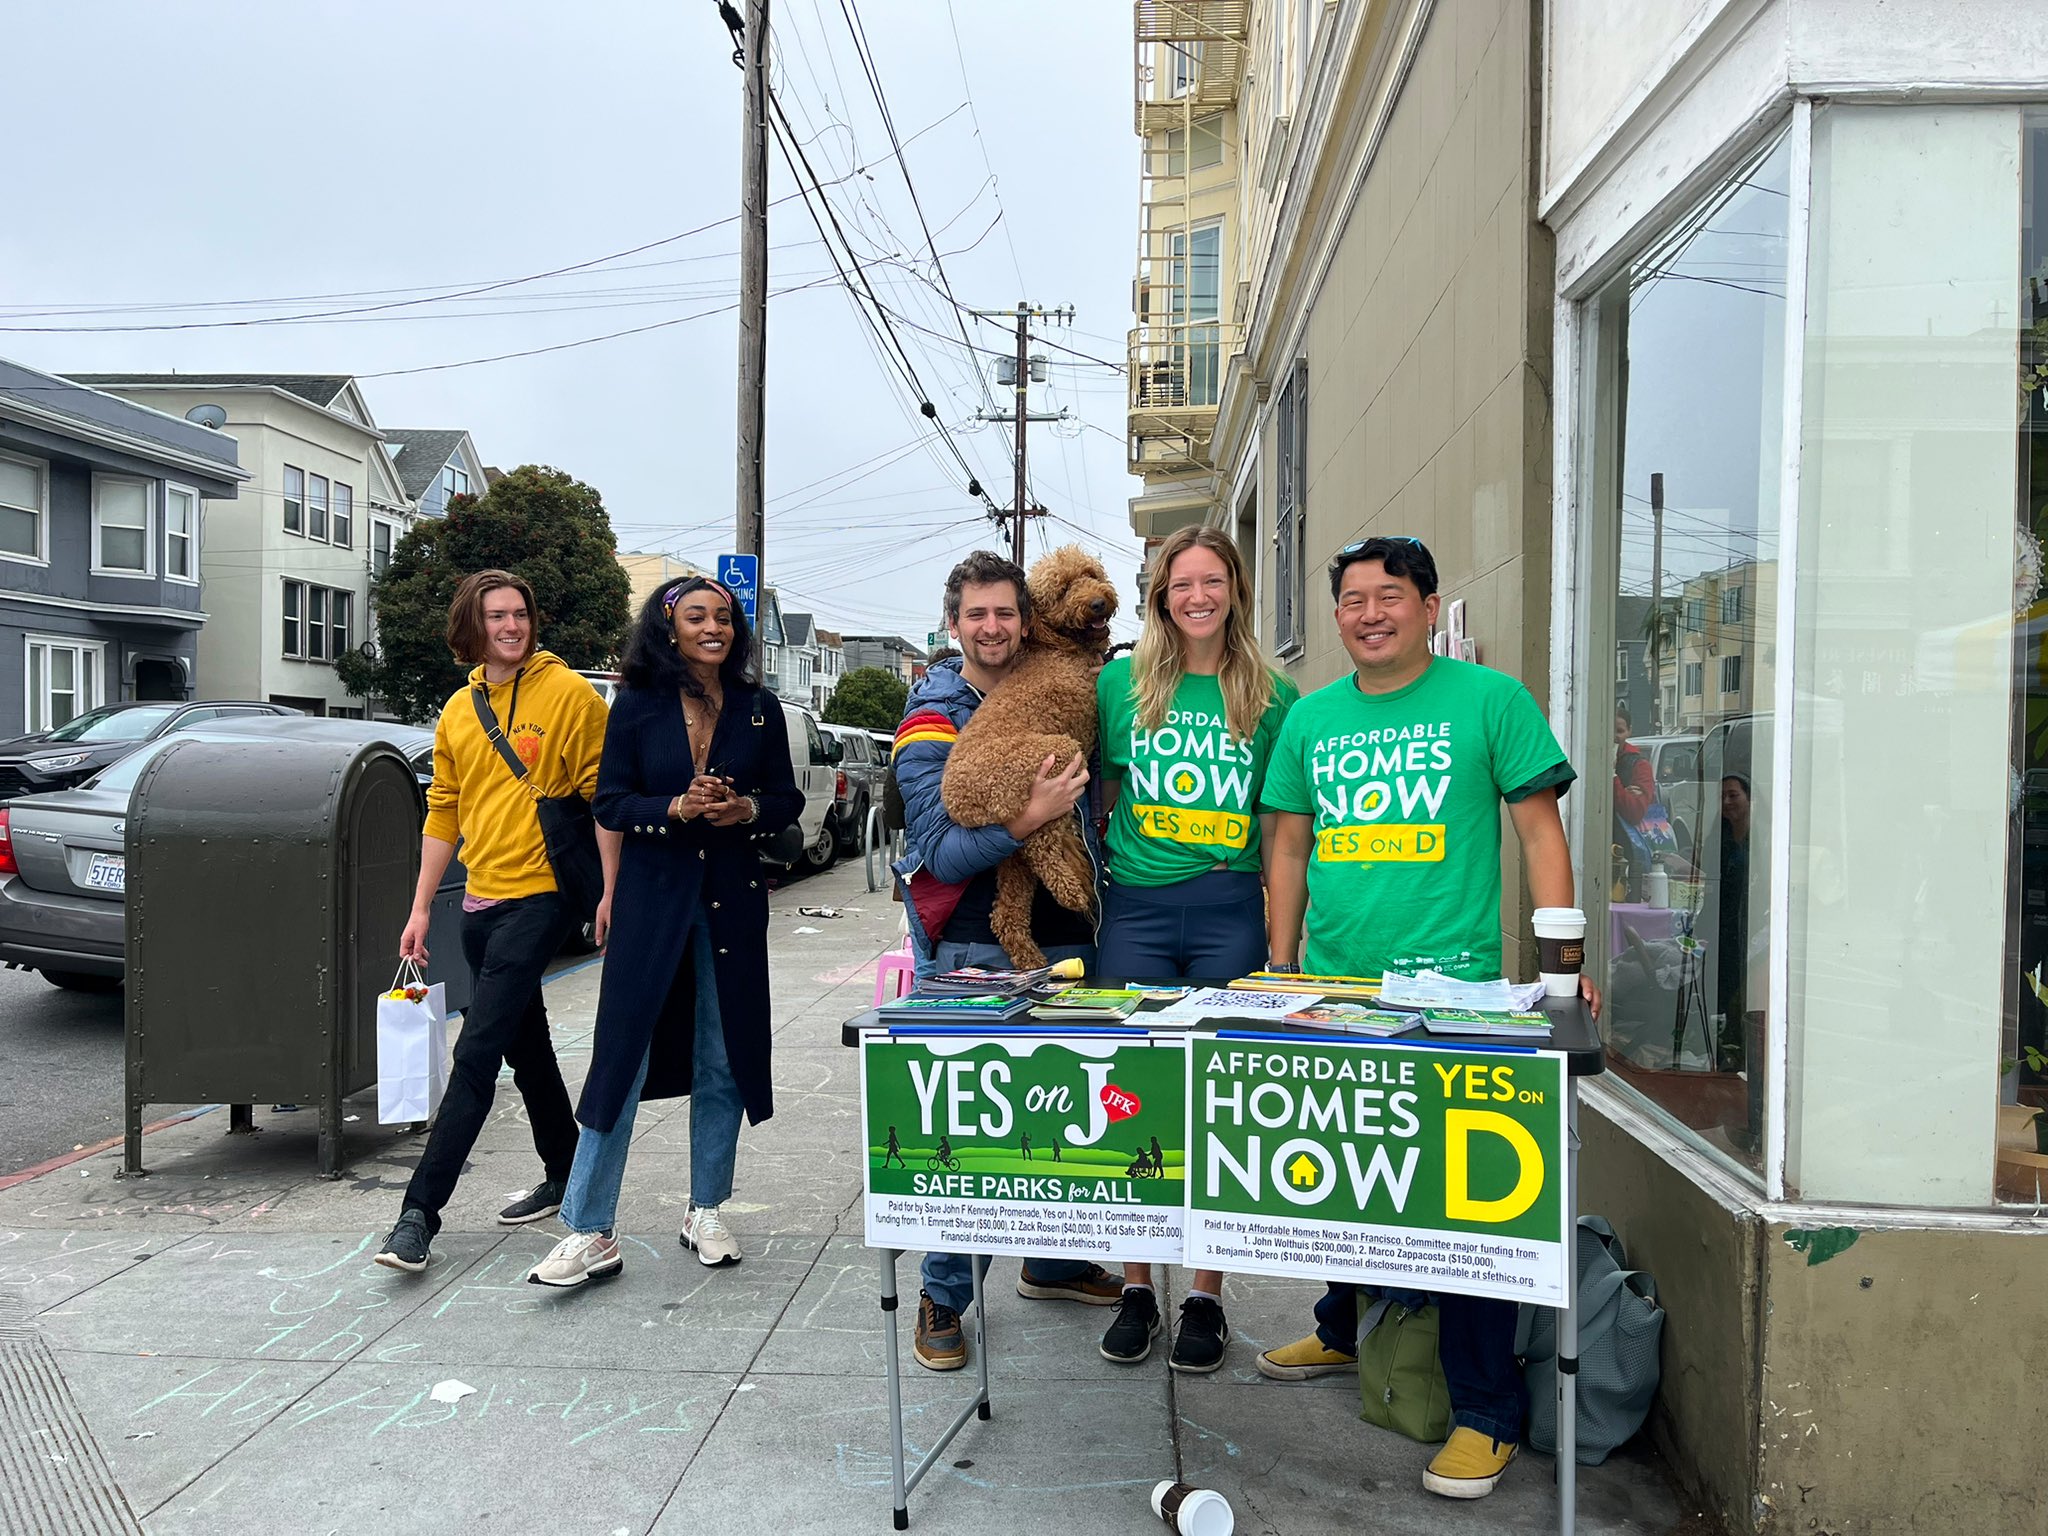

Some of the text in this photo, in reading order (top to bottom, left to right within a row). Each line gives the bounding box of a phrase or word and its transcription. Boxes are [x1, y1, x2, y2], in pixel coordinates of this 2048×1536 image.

[512, 722, 546, 738] NEW YORK
[1130, 727, 1254, 766] HOMES
[1314, 722, 1451, 754] AFFORDABLE
[1312, 740, 1452, 786] HOMES
[1128, 760, 1253, 810] NOW
[1317, 774, 1452, 828] NOW
[1136, 809, 1243, 840] YES ON D
[1319, 831, 1437, 854] YES ON D
[1206, 1051, 1416, 1086] AFFORDABLE
[1433, 1063, 1543, 1104] YES ON
[908, 1060, 1115, 1146] YES on J
[1103, 1090, 1136, 1116] JFK
[1206, 1079, 1420, 1138] HOMES
[1206, 1132, 1421, 1214] NOW
[1446, 1108, 1545, 1223] D
[912, 1174, 1142, 1203] SAFE PARKS for ALL
[876, 1213, 900, 1226] funding
[902, 1214, 918, 1225] from:
[920, 1216, 926, 1226] 1.
[928, 1216, 954, 1227] Emmett
[956, 1218, 975, 1228] Shear
[1011, 1221, 1017, 1230] 2.
[1018, 1221, 1035, 1232] Zack
[1037, 1222, 1060, 1233] Rosen
[1097, 1224, 1103, 1235] 3.
[1105, 1224, 1117, 1235] Kid
[1119, 1226, 1135, 1236] Safe
[1137, 1227, 1147, 1237] SF
[889, 1201, 902, 1212] Paid
[904, 1202, 914, 1211] for
[915, 1203, 922, 1215] by
[925, 1203, 941, 1213] Save
[943, 1204, 960, 1214] John
[961, 1205, 966, 1214] F
[967, 1205, 998, 1217] Kennedy
[1000, 1206, 1041, 1219] Promenade,
[1043, 1208, 1056, 1218] Yes
[1076, 1210, 1087, 1220] No
[1088, 1212, 1098, 1220] on
[1105, 1210, 1145, 1222] Committee
[1147, 1212, 1168, 1225] major
[941, 1230, 1112, 1251] Financial disclosures are available at sfethics.org.
[1204, 1219, 1539, 1259] Paid for by Affordable Homes Now San Francisco. Committee major funding from:
[1243, 1236, 1496, 1269] 1. John Wolthuis ($200,000), 2. Marco Zappacosta ($150,000),
[1207, 1245, 1536, 1287] 3. Benjamin Spero ($100,000) Financial disclosures are available at sfethics.org.
[253, 1315, 441, 1364] the
